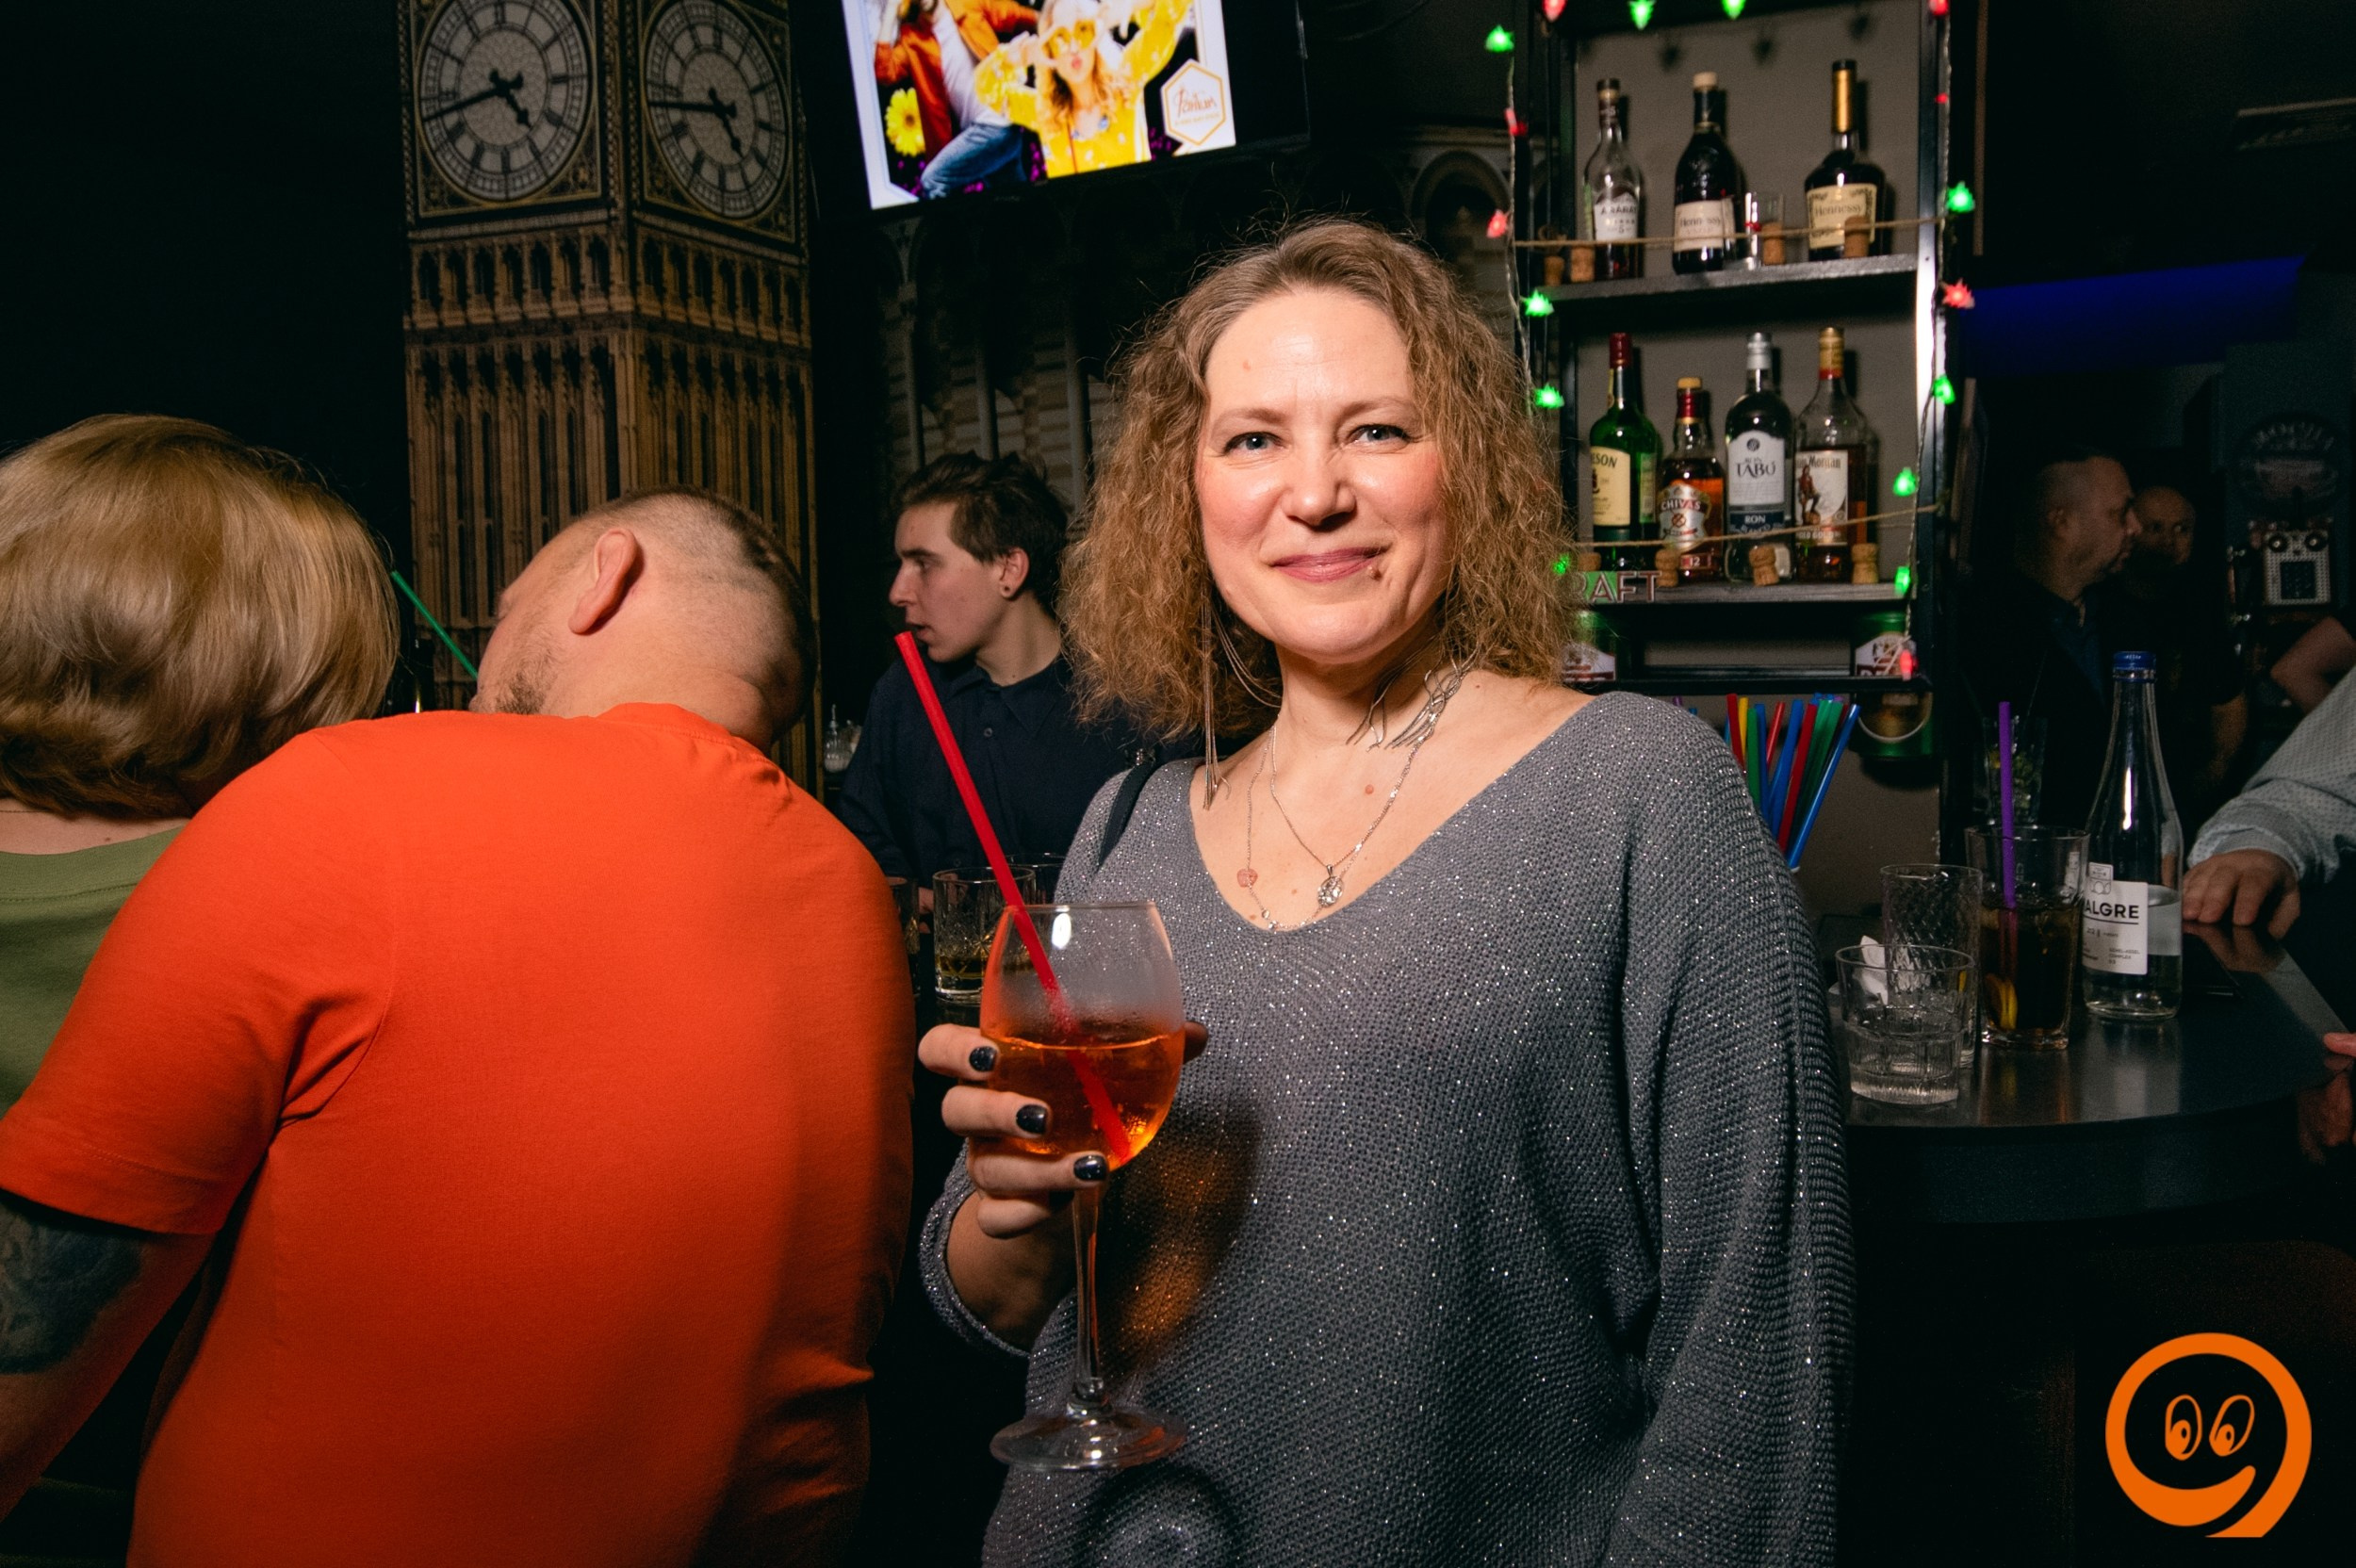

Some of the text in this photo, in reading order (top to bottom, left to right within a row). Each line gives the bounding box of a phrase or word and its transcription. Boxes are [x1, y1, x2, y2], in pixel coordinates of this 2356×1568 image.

[1680, 216, 1721, 227] Hennssy
[1661, 498, 1701, 511] CHIVAS
[1744, 514, 1766, 525] RON
